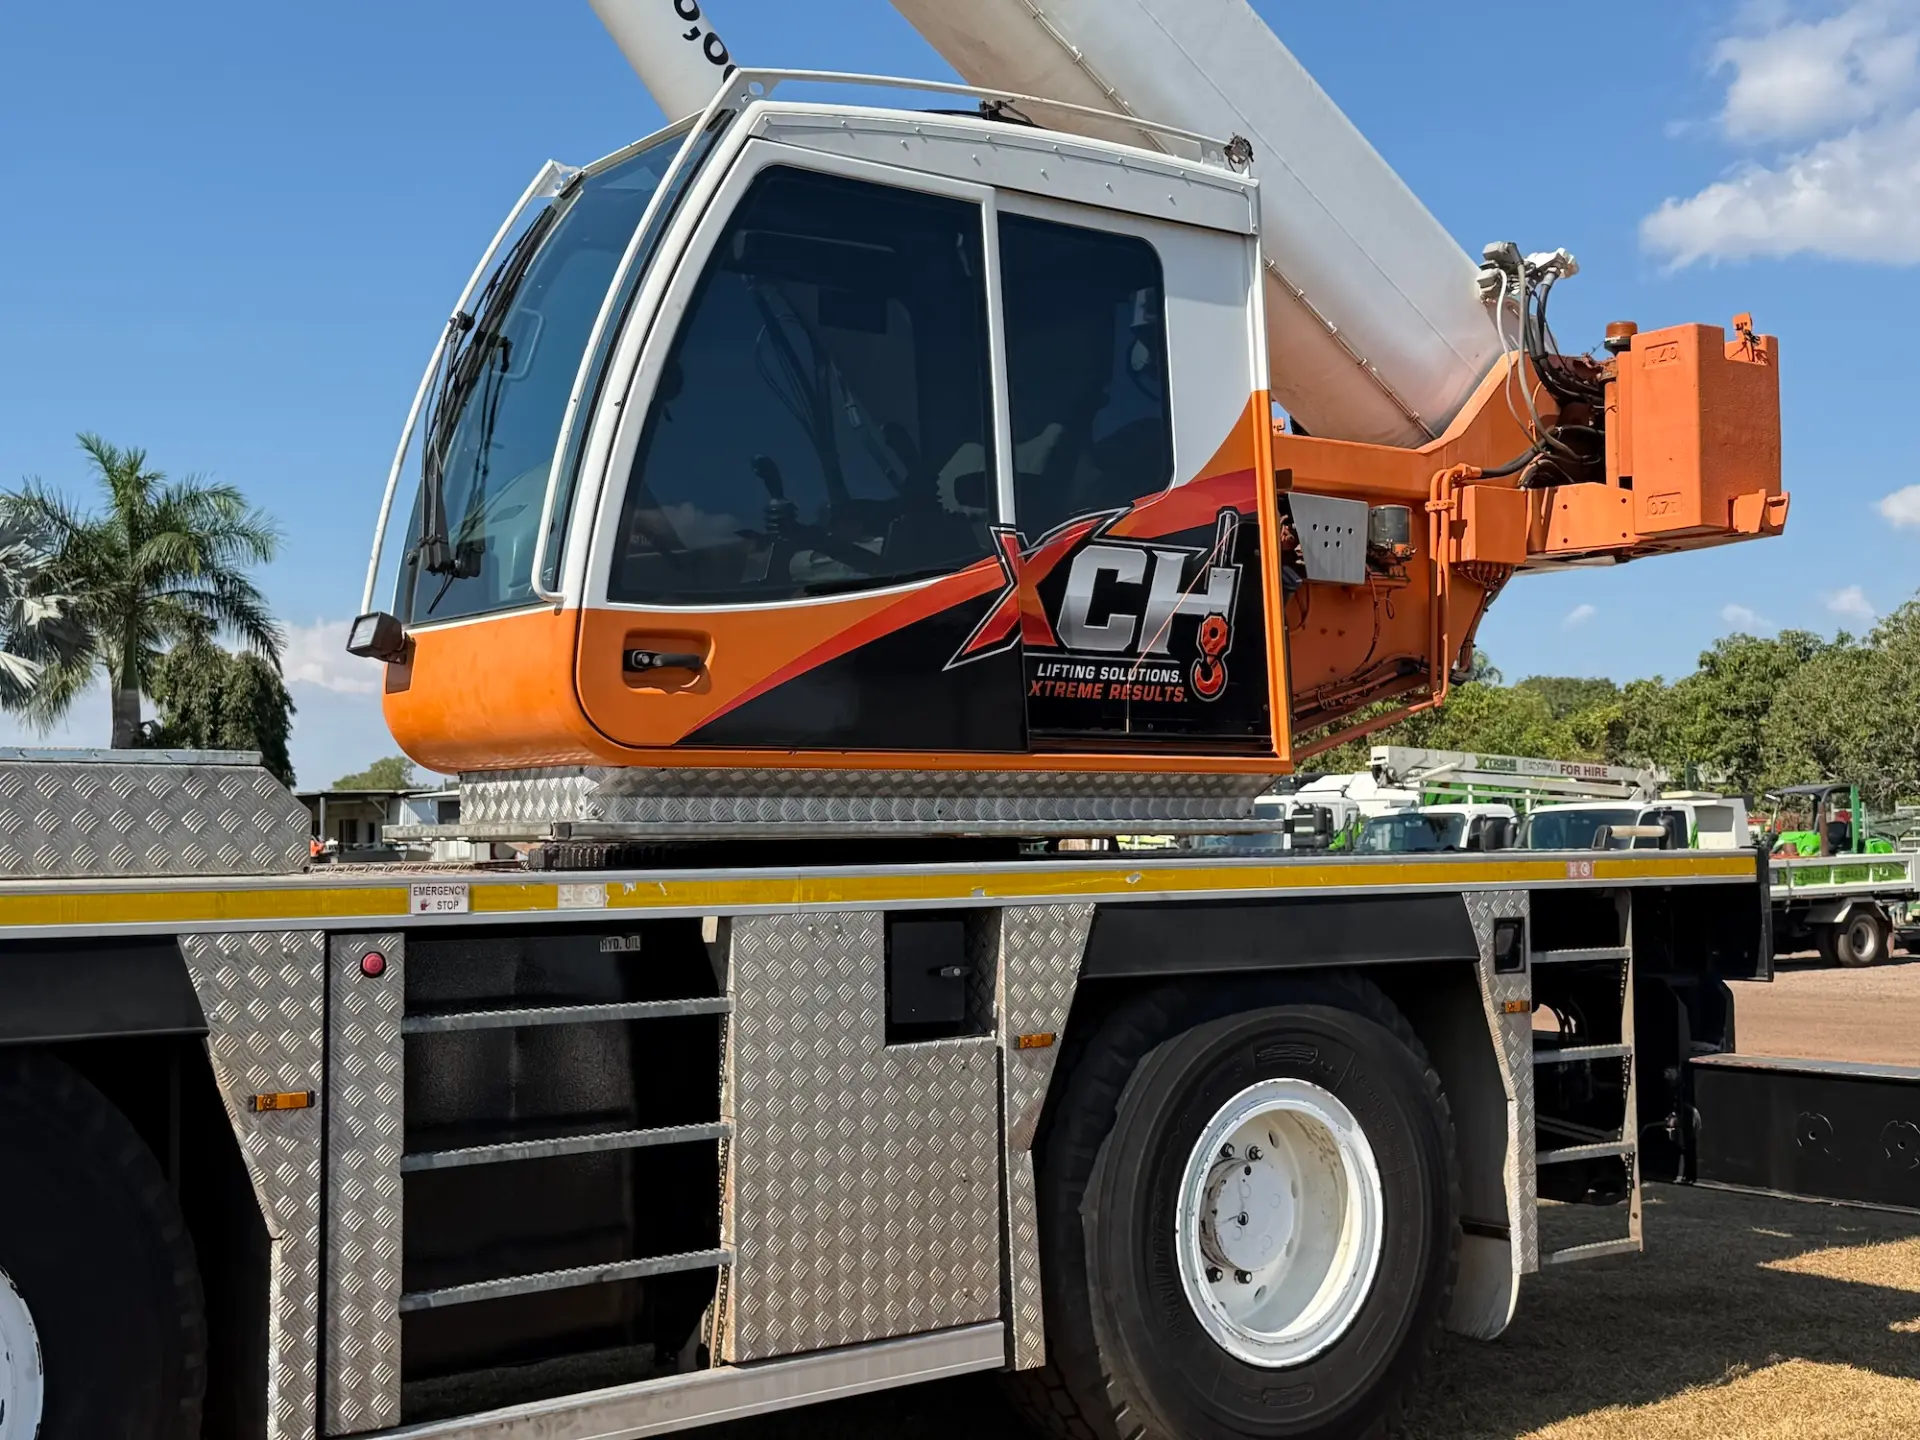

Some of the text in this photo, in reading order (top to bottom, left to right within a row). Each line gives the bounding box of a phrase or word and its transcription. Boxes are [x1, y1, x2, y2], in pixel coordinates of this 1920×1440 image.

[1037, 663, 1183, 683] LIFTING SOLUTIONS.
[1028, 680, 1188, 703] XTREME RESULTS.
[1560, 764, 1581, 776] FOR
[1583, 765, 1609, 778] HIRE
[413, 885, 467, 897] EMERGENCY
[437, 900, 460, 910] STOP
